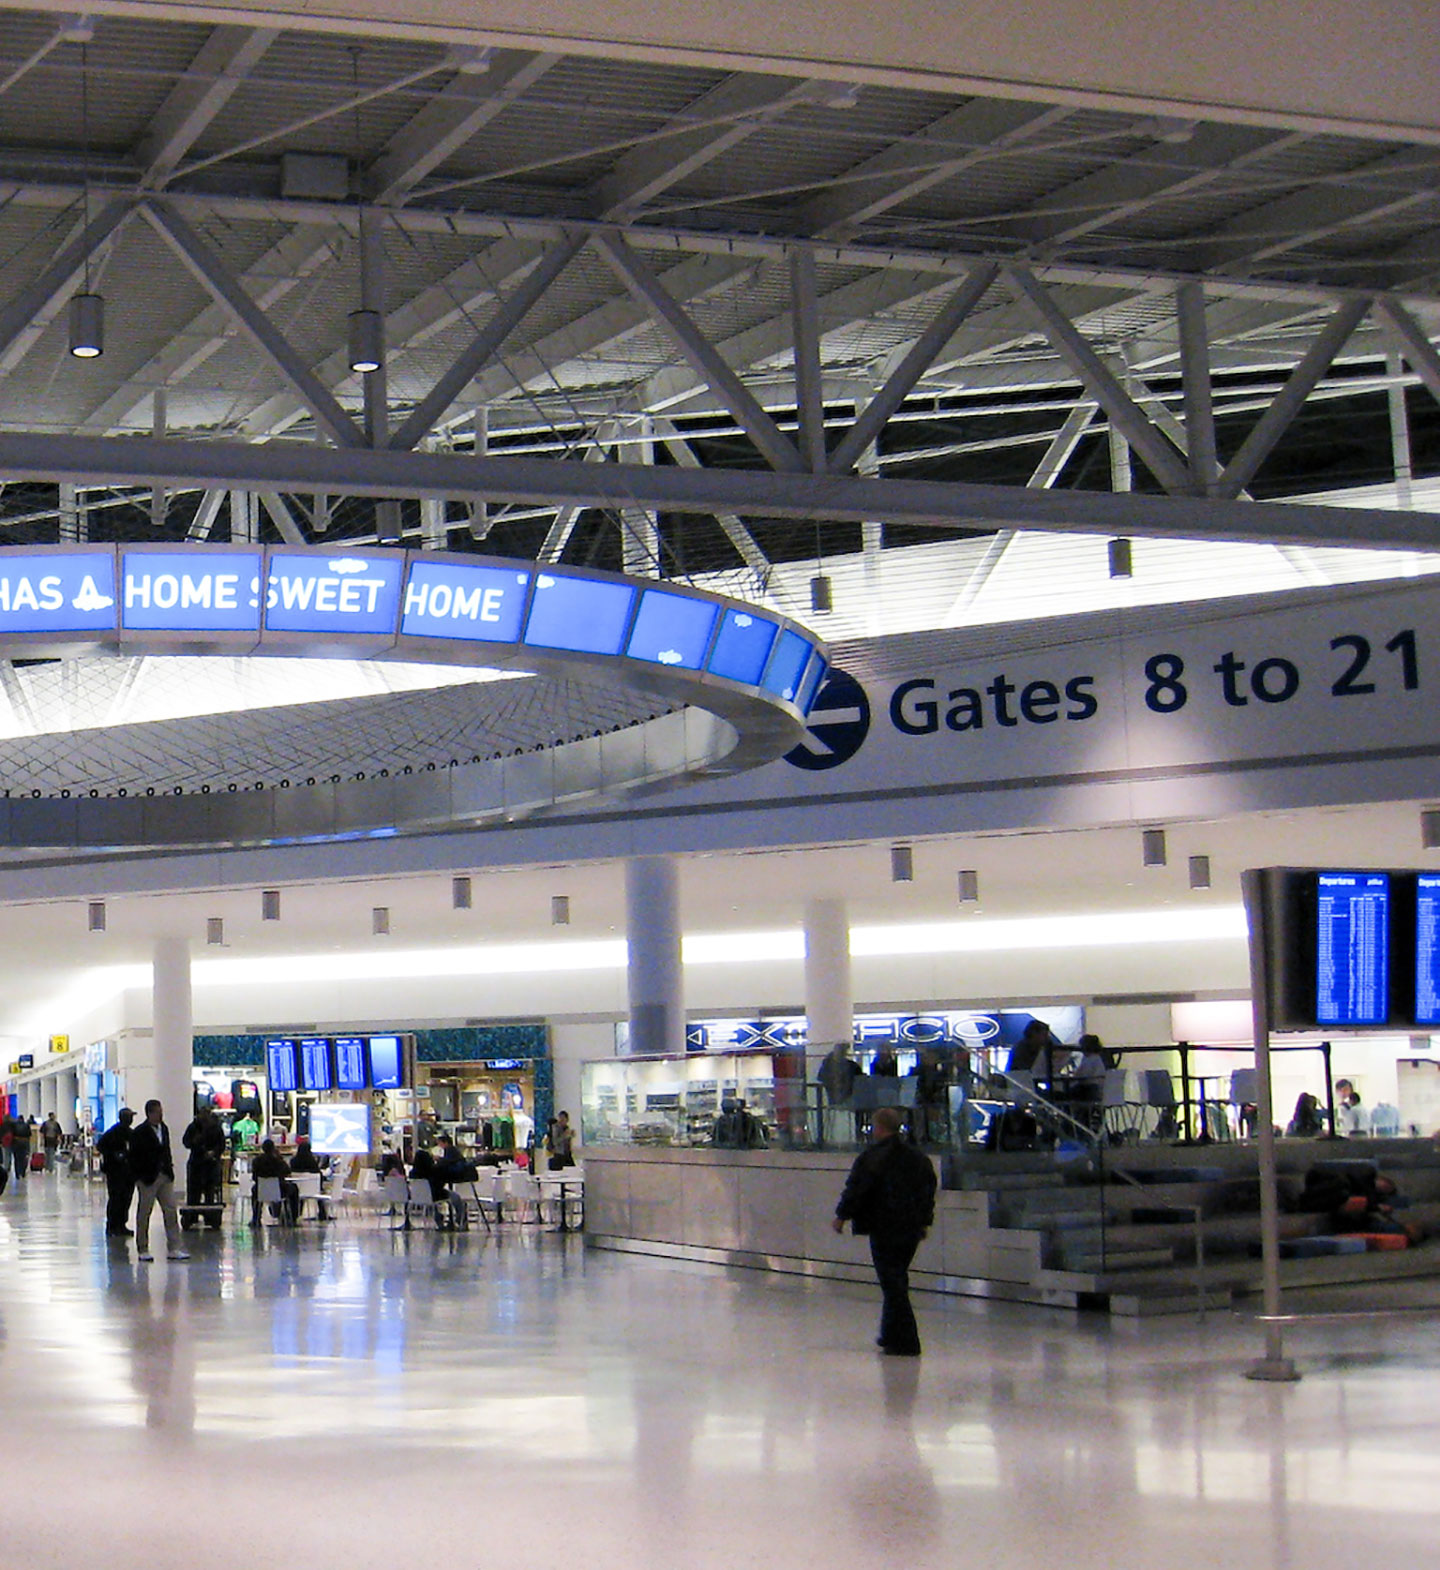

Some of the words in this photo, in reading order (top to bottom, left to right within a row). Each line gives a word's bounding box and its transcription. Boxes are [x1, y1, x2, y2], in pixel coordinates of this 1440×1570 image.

[76, 575, 101, 609] A
[125, 574, 239, 609] HOME
[249, 576, 386, 613] SWEET
[403, 581, 504, 622] HOME
[889, 673, 1098, 736] Gates
[1144, 653, 1188, 713] 8
[1214, 651, 1299, 707] to
[1330, 629, 1420, 697] 21
[56, 1041, 63, 1051] 8
